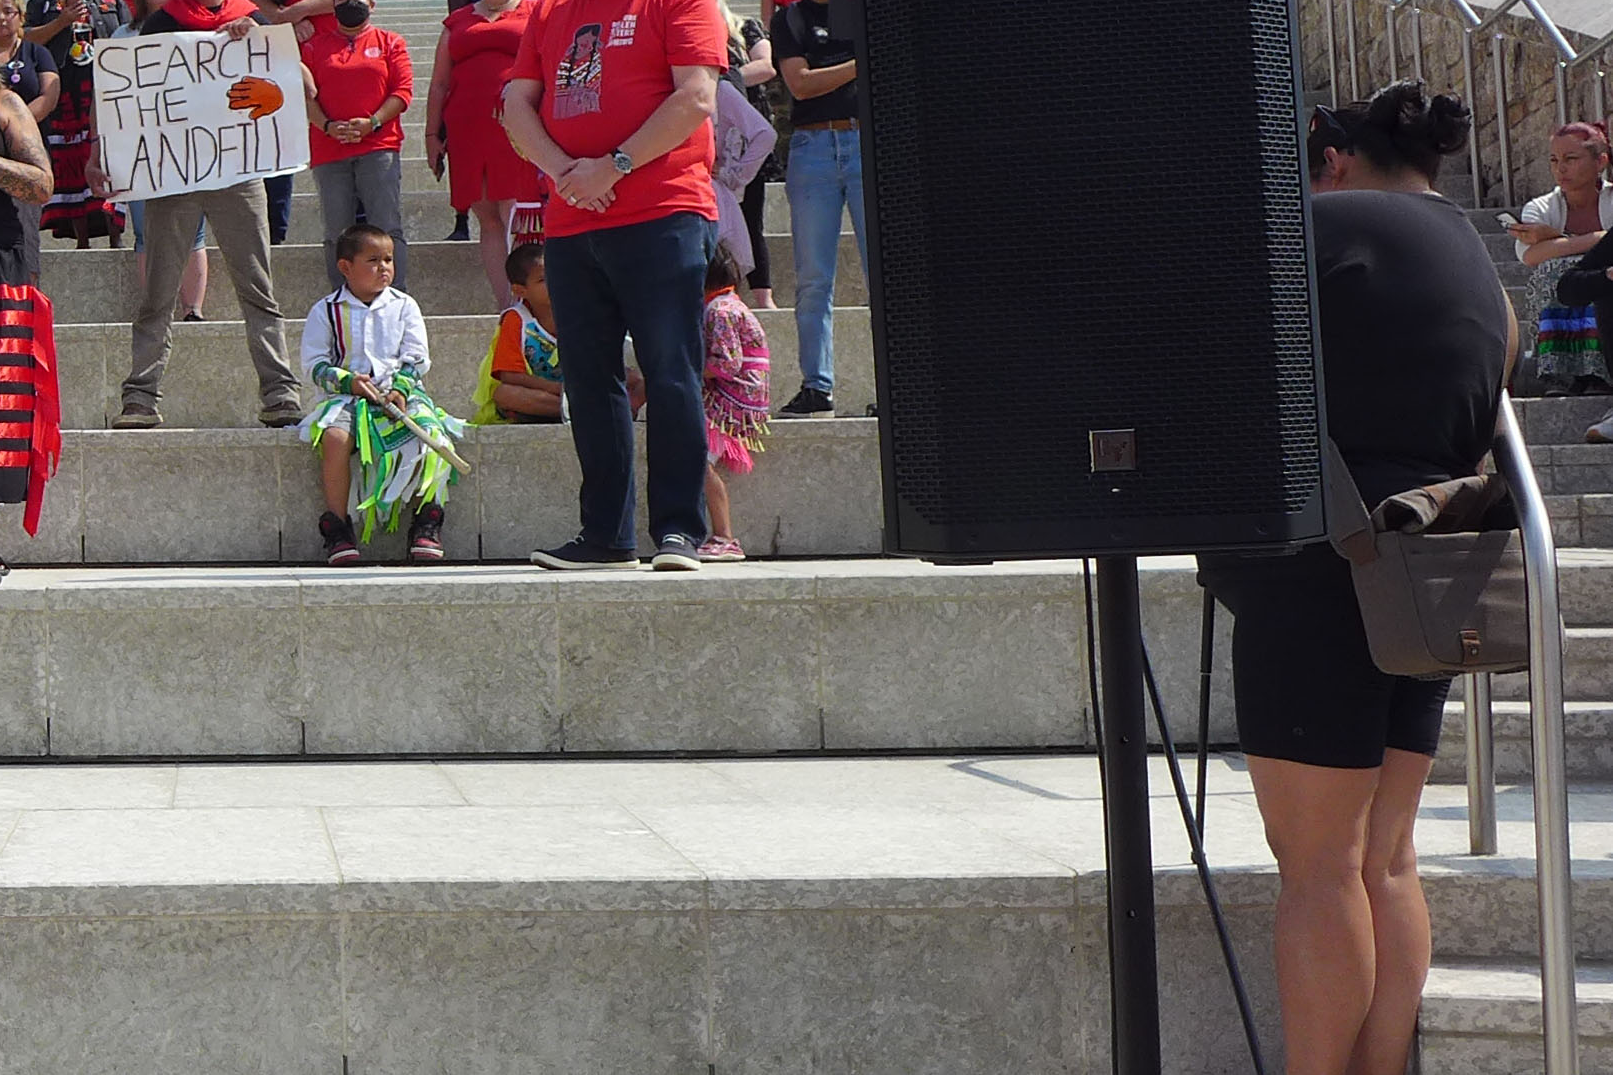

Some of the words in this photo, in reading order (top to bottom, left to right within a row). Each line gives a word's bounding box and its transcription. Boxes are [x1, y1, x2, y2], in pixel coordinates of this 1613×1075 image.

[97, 35, 271, 94] SEARCH
[102, 86, 189, 130] THE
[98, 116, 299, 194] LANDFILL
